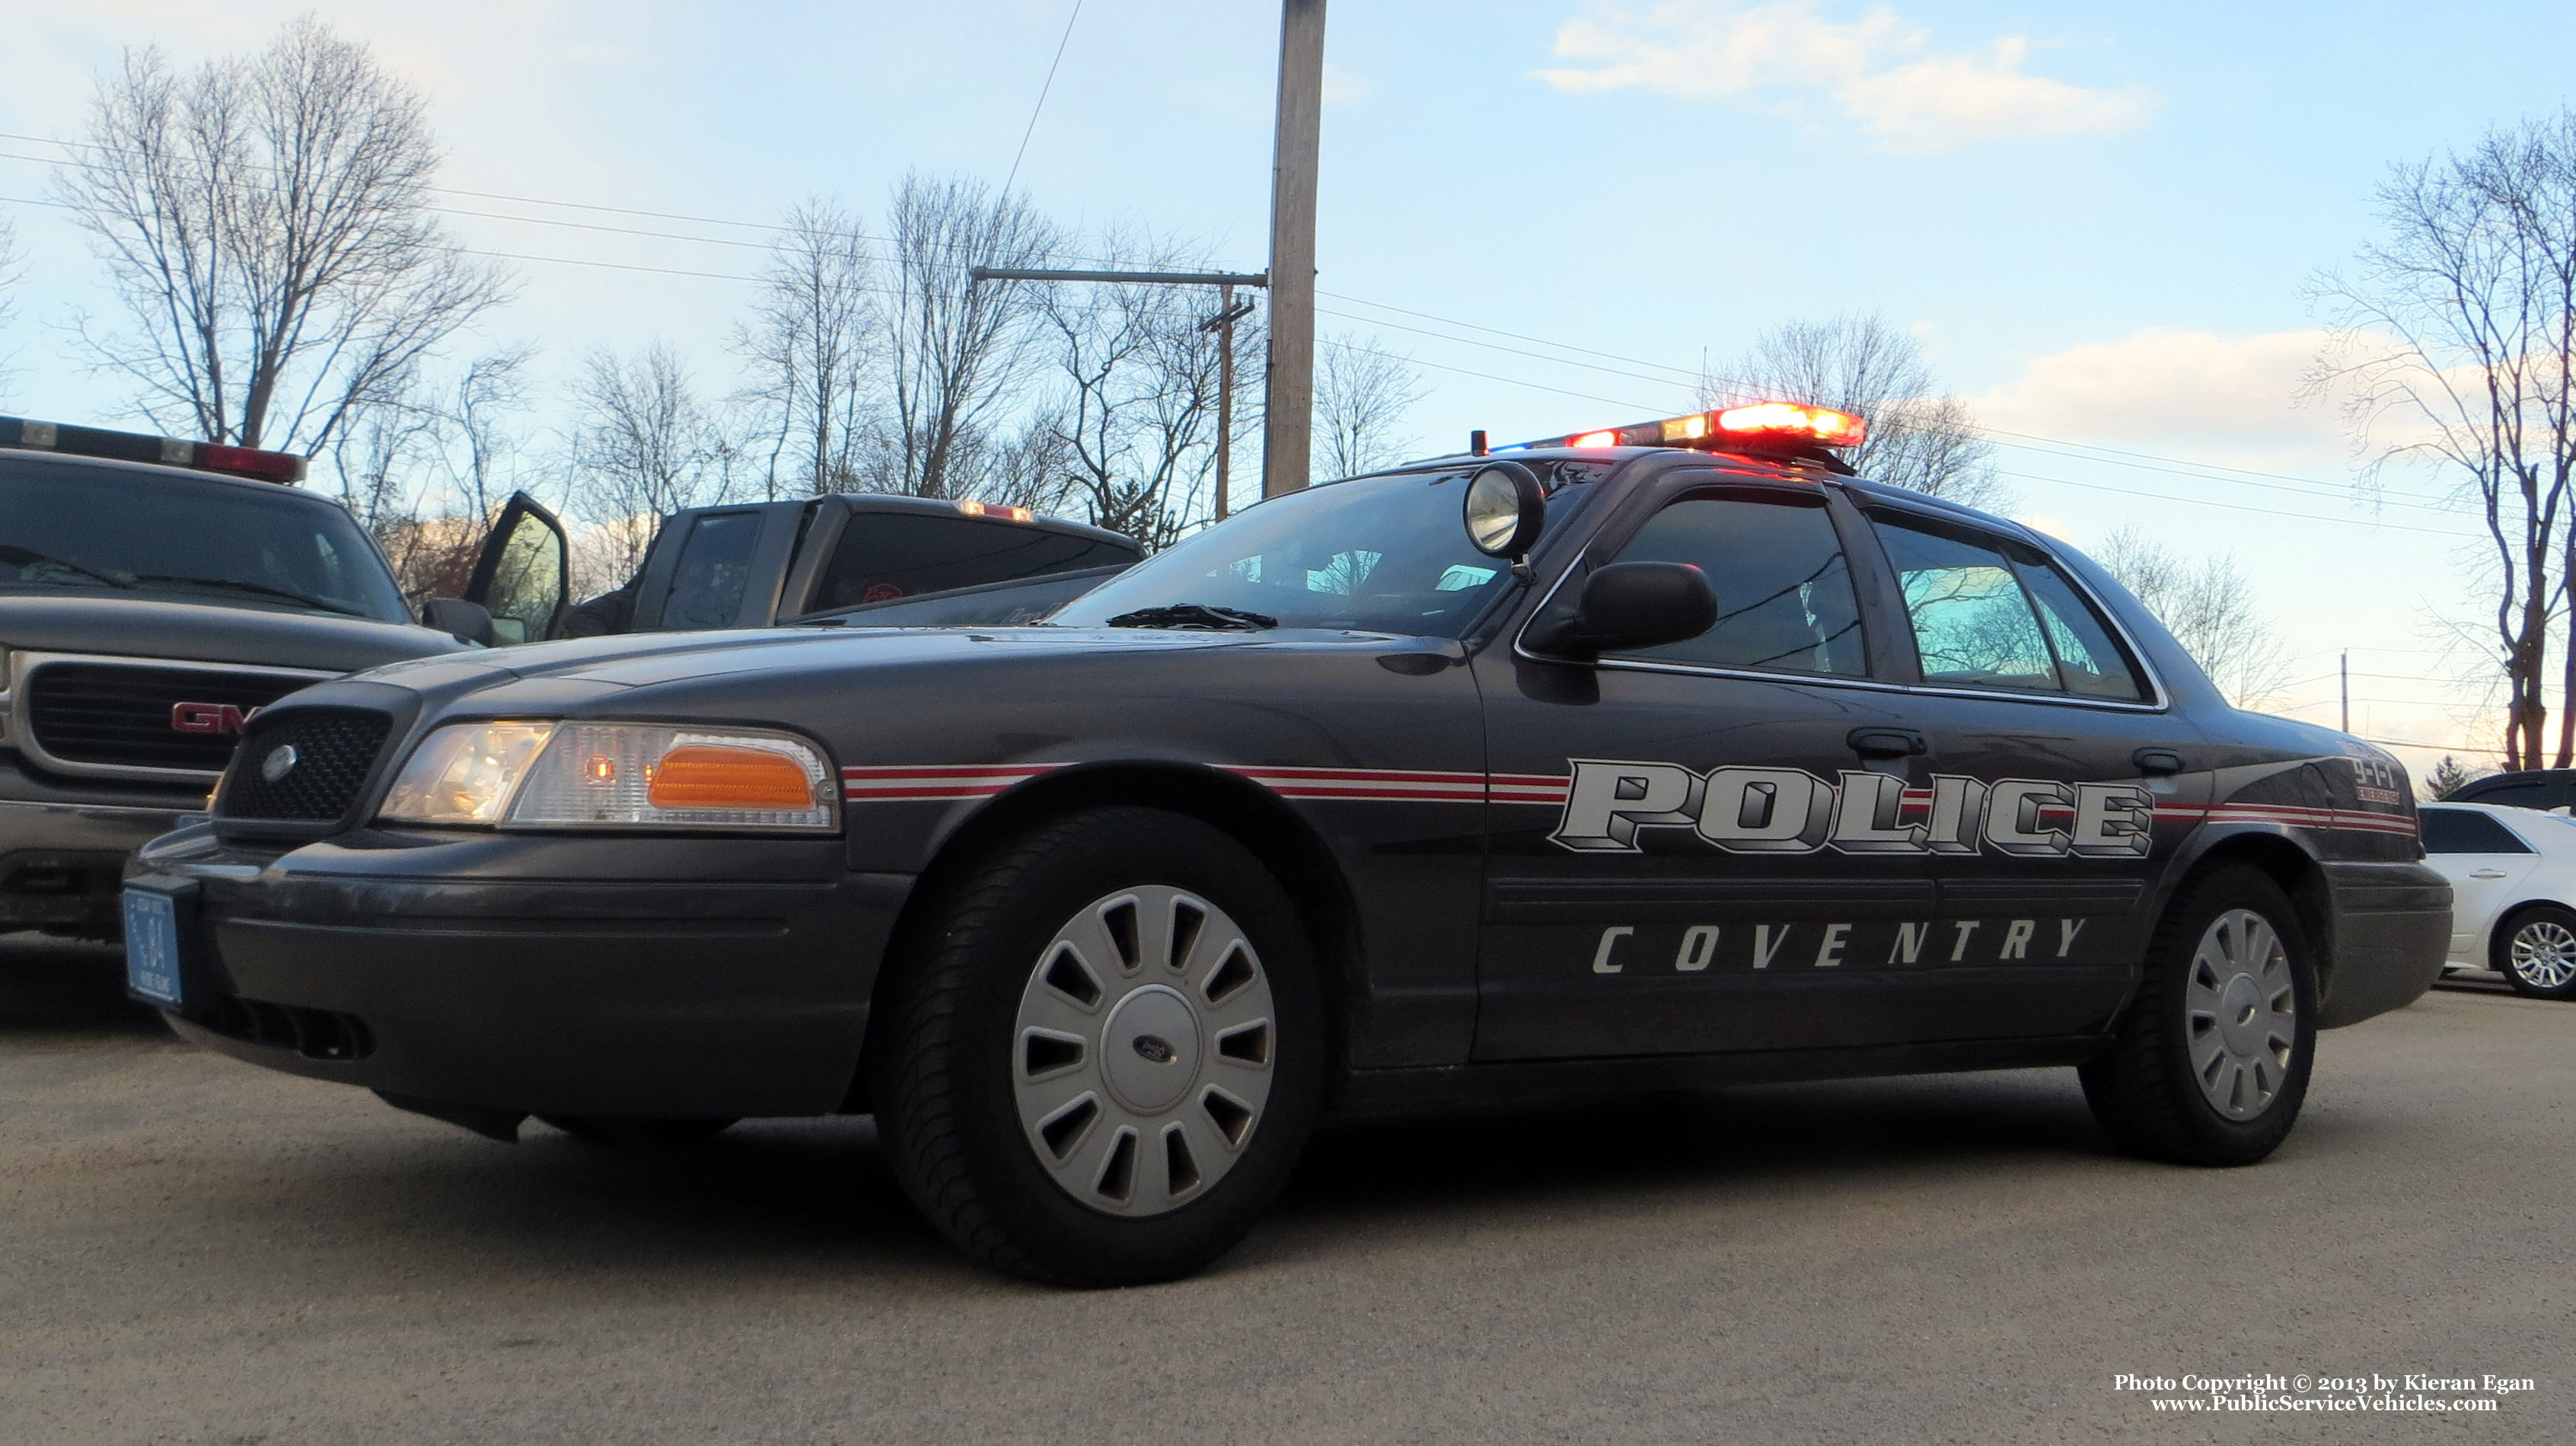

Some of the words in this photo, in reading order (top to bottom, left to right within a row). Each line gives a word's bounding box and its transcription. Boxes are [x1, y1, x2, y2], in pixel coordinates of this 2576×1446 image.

[172, 701, 263, 733] GM
[1546, 758, 2154, 857] POLICE
[1592, 918, 2085, 974] COVENTRY
